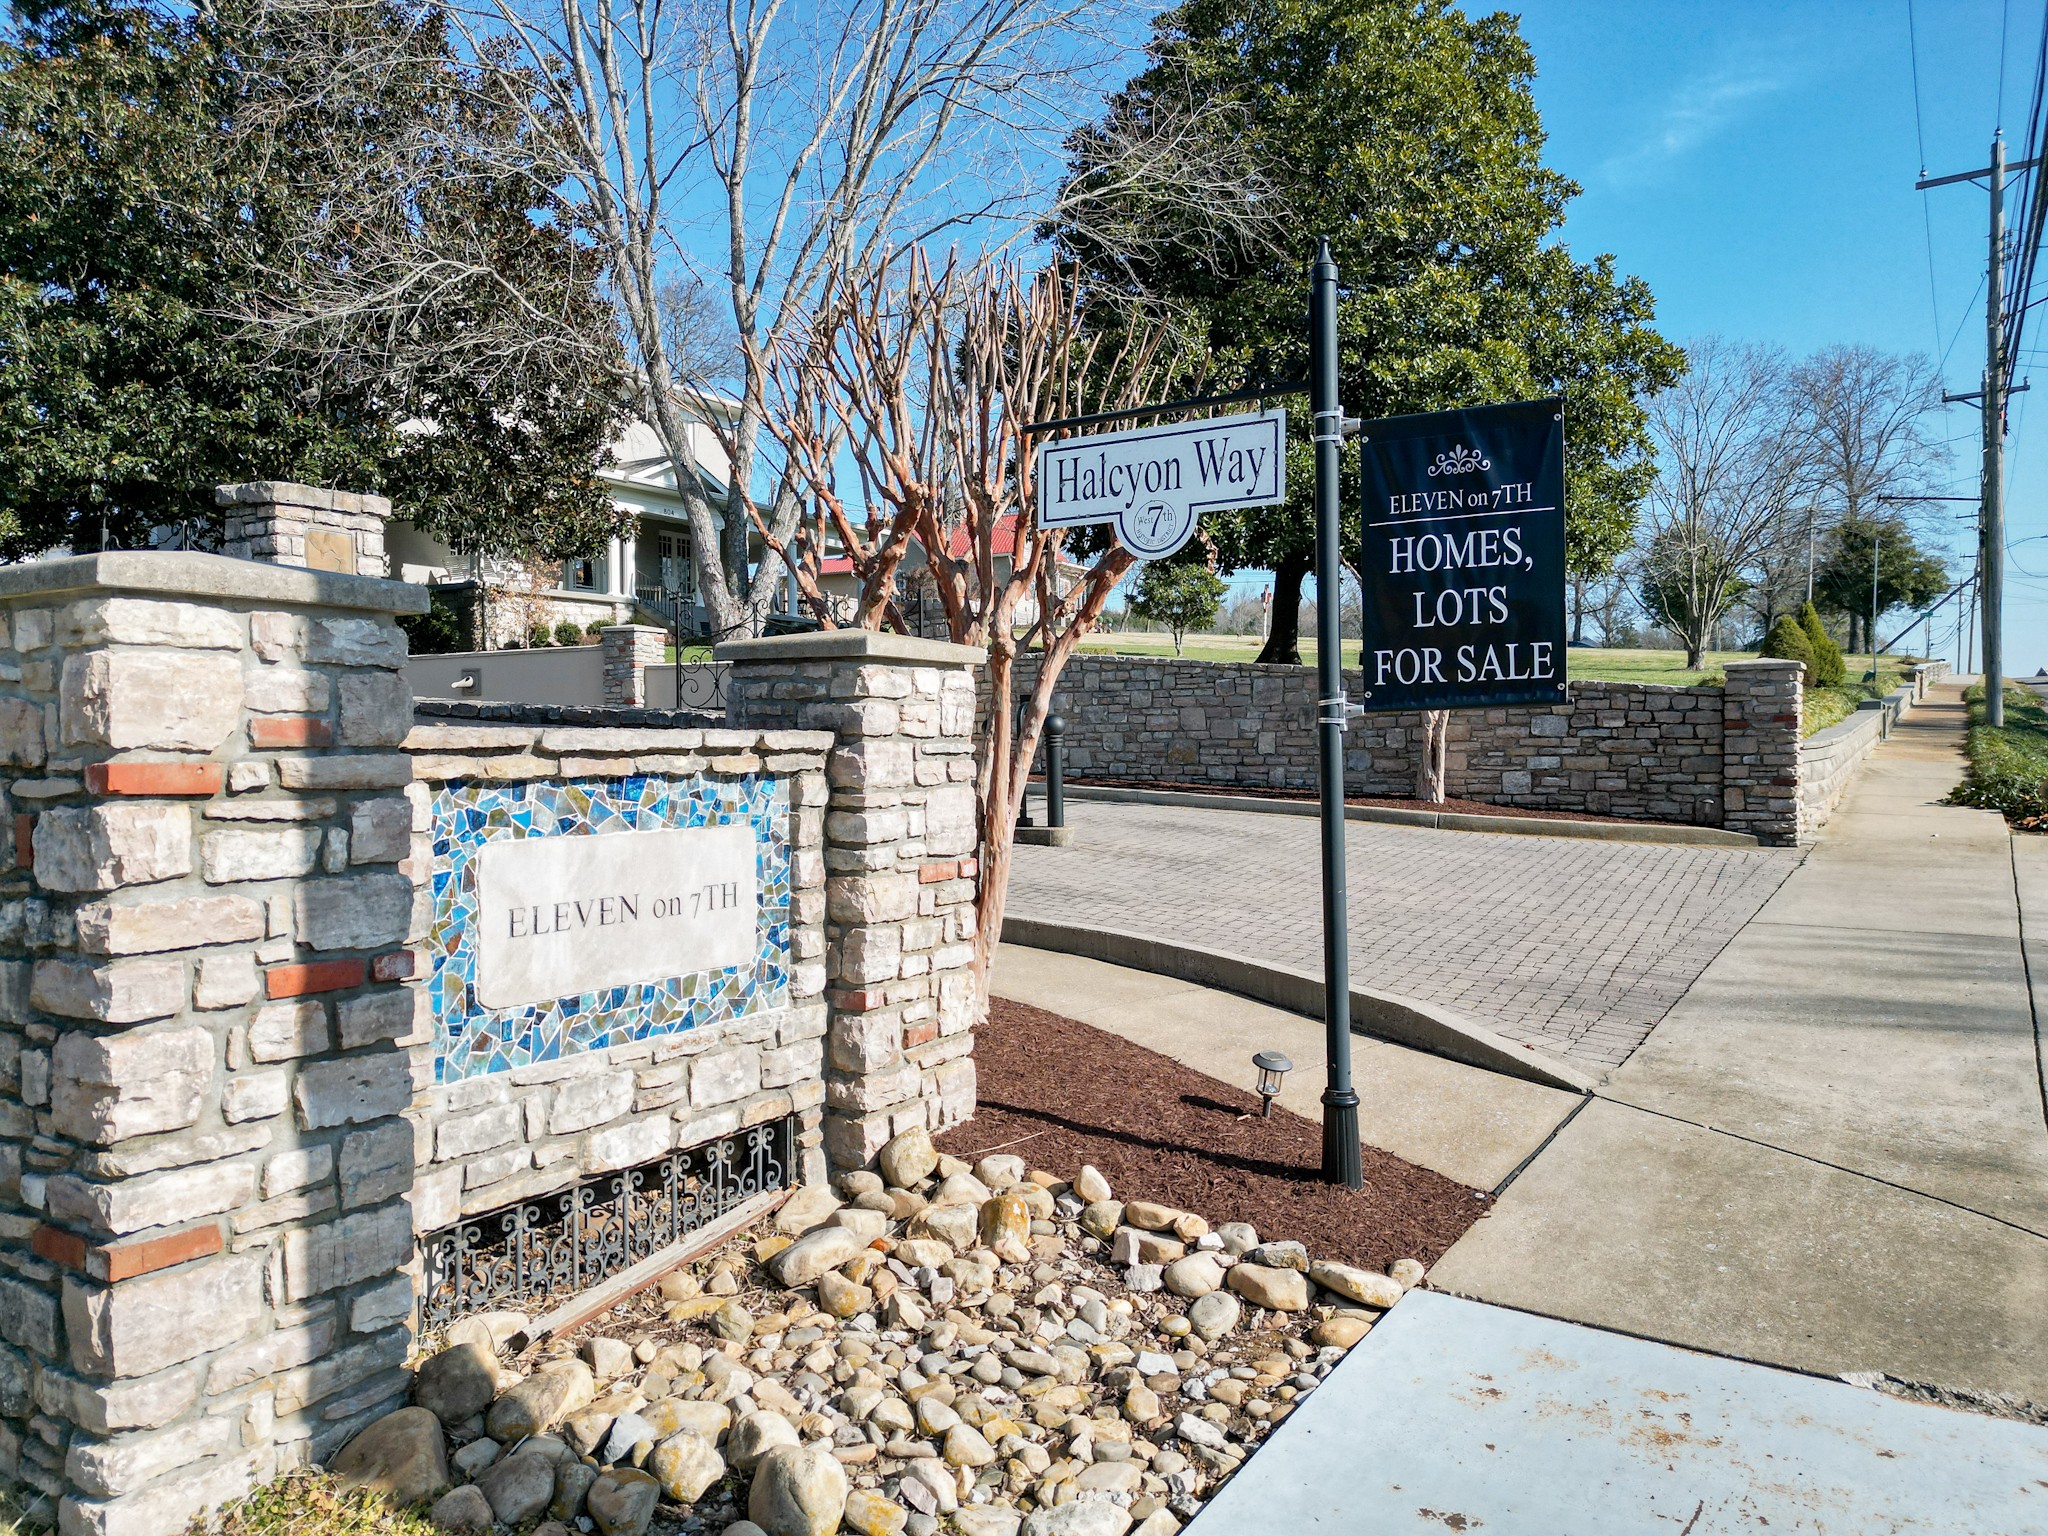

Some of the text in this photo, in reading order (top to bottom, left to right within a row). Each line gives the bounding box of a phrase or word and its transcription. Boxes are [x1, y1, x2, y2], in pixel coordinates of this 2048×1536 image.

[1056, 437, 1266, 509] Halcyon Way
[1137, 515, 1154, 526] West
[1389, 482, 1533, 515] ELEVEN on 7TH
[1388, 526, 1534, 574] HOMES,
[1412, 585, 1509, 628] LOTS
[1374, 641, 1555, 686] FOR SALE
[508, 881, 739, 939] ELEVEN on 7TH
